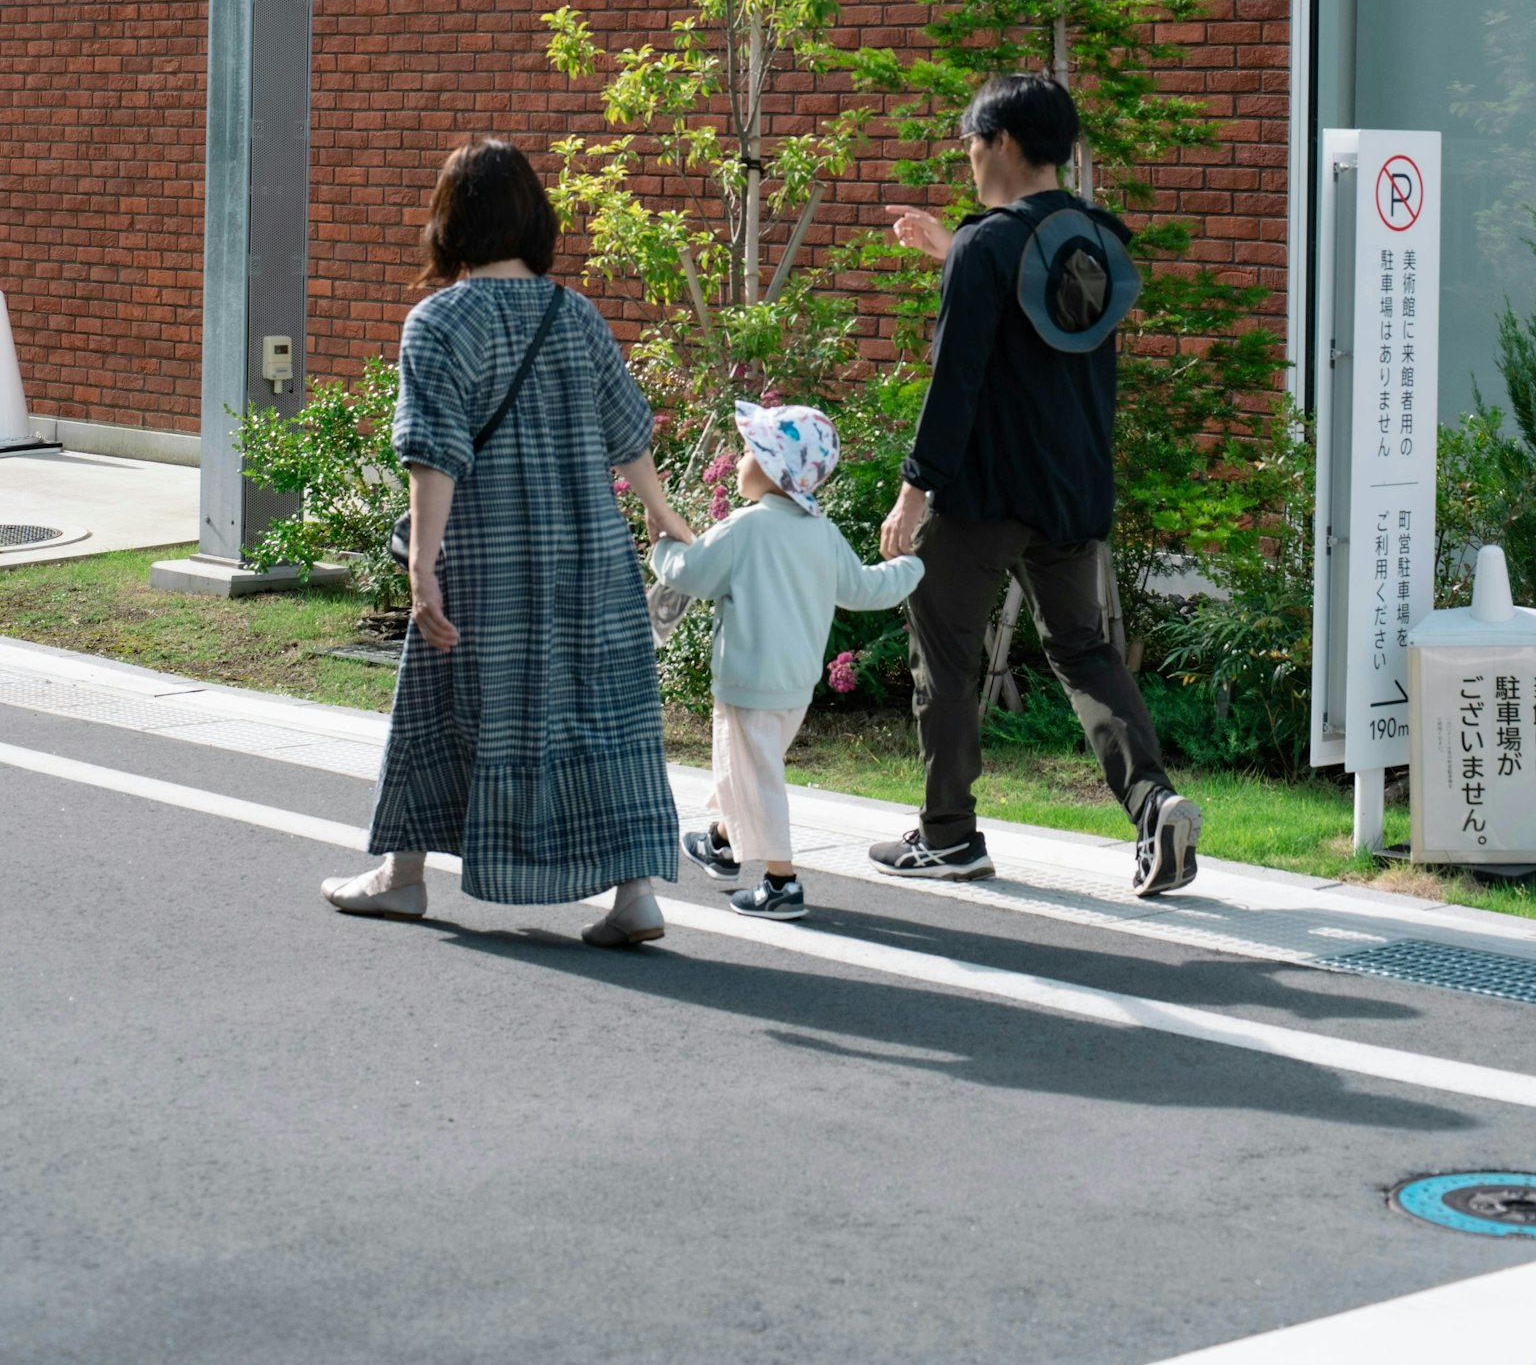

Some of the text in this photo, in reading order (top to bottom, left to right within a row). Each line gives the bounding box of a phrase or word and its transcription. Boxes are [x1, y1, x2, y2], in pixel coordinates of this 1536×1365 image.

[1390, 173, 1412, 217] P
[1377, 249, 1394, 457] 駐車場はありません
[1399, 249, 1417, 456] 美術館に来館者用の
[1373, 510, 1390, 670] ご利用ください
[1396, 509, 1412, 648] 町営駐車場を
[1369, 717, 1409, 740] 190m
[1459, 675, 1487, 846] ございません。
[1495, 675, 1522, 776] 駐車場が
